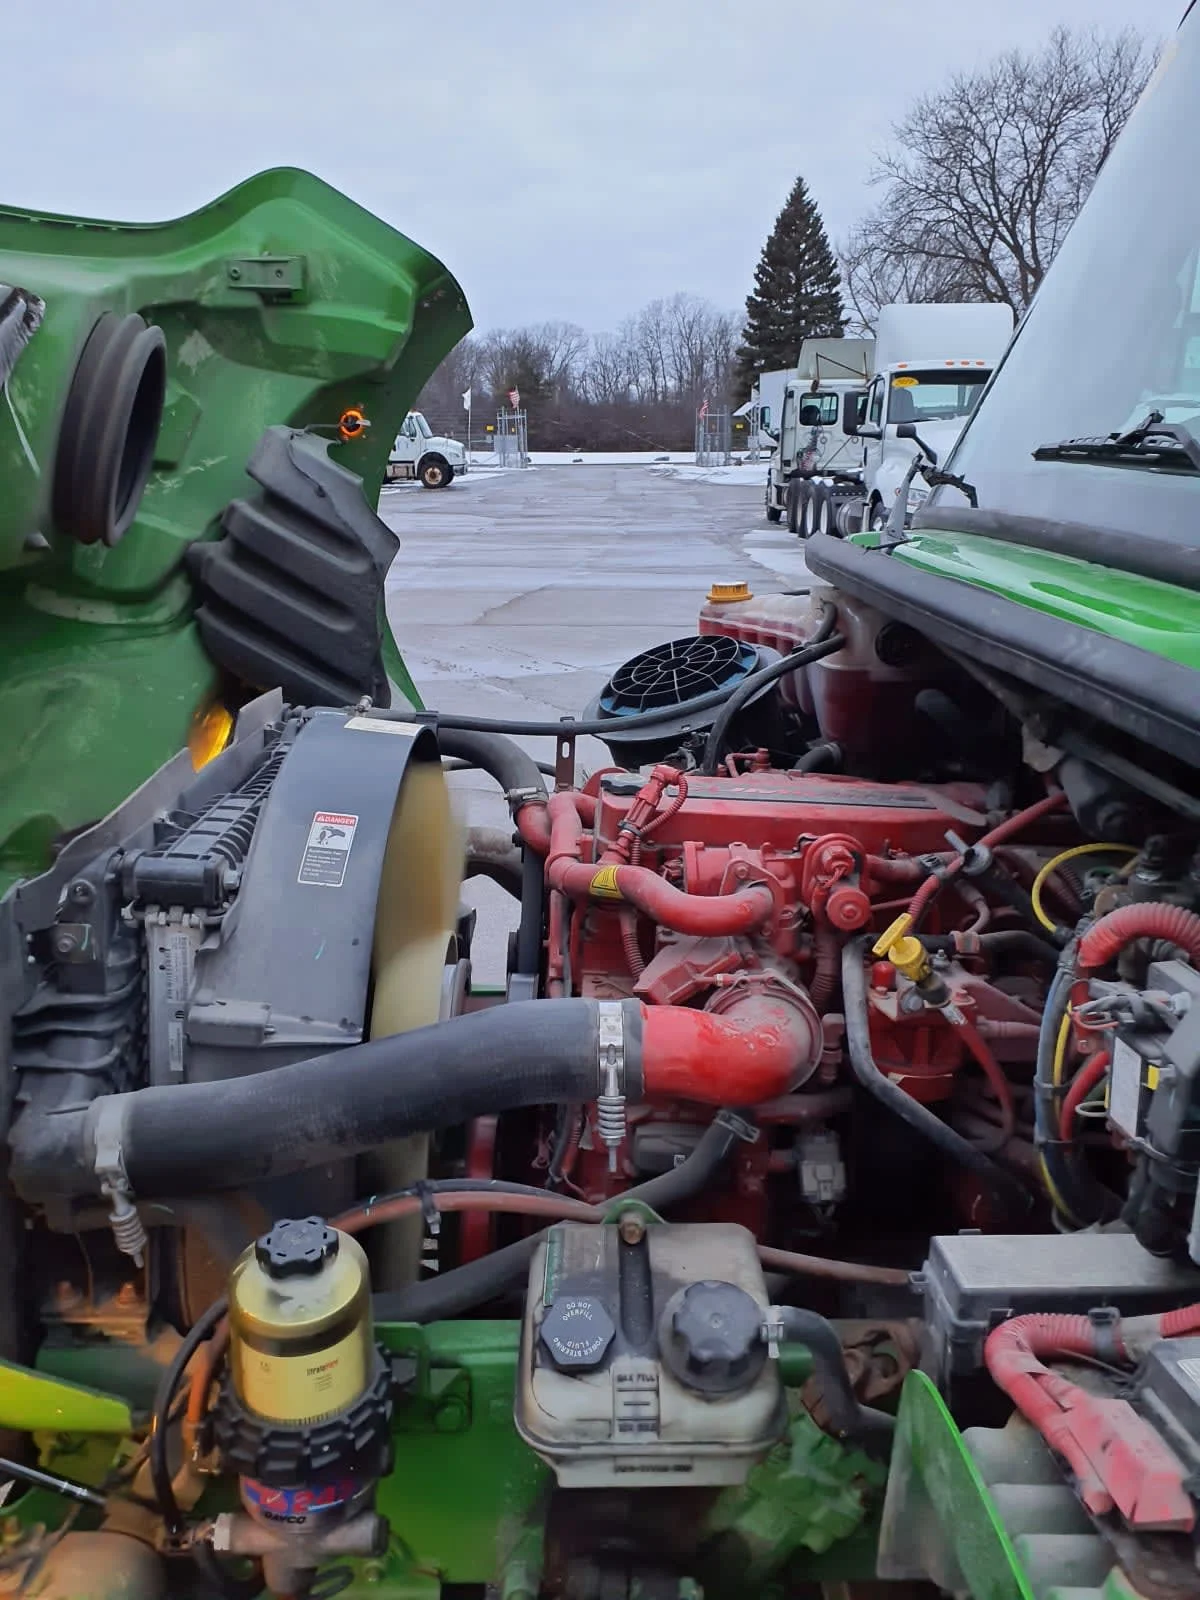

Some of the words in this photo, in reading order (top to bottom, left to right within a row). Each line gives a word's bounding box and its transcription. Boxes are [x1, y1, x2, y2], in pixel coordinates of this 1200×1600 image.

[325, 815, 355, 825] DANGER
[566, 1302, 576, 1310] DO
[578, 1301, 592, 1310] NOT
[563, 1309, 592, 1321] OVERFILL
[567, 1340, 590, 1349] FLUID
[583, 1336, 604, 1356] POWER
